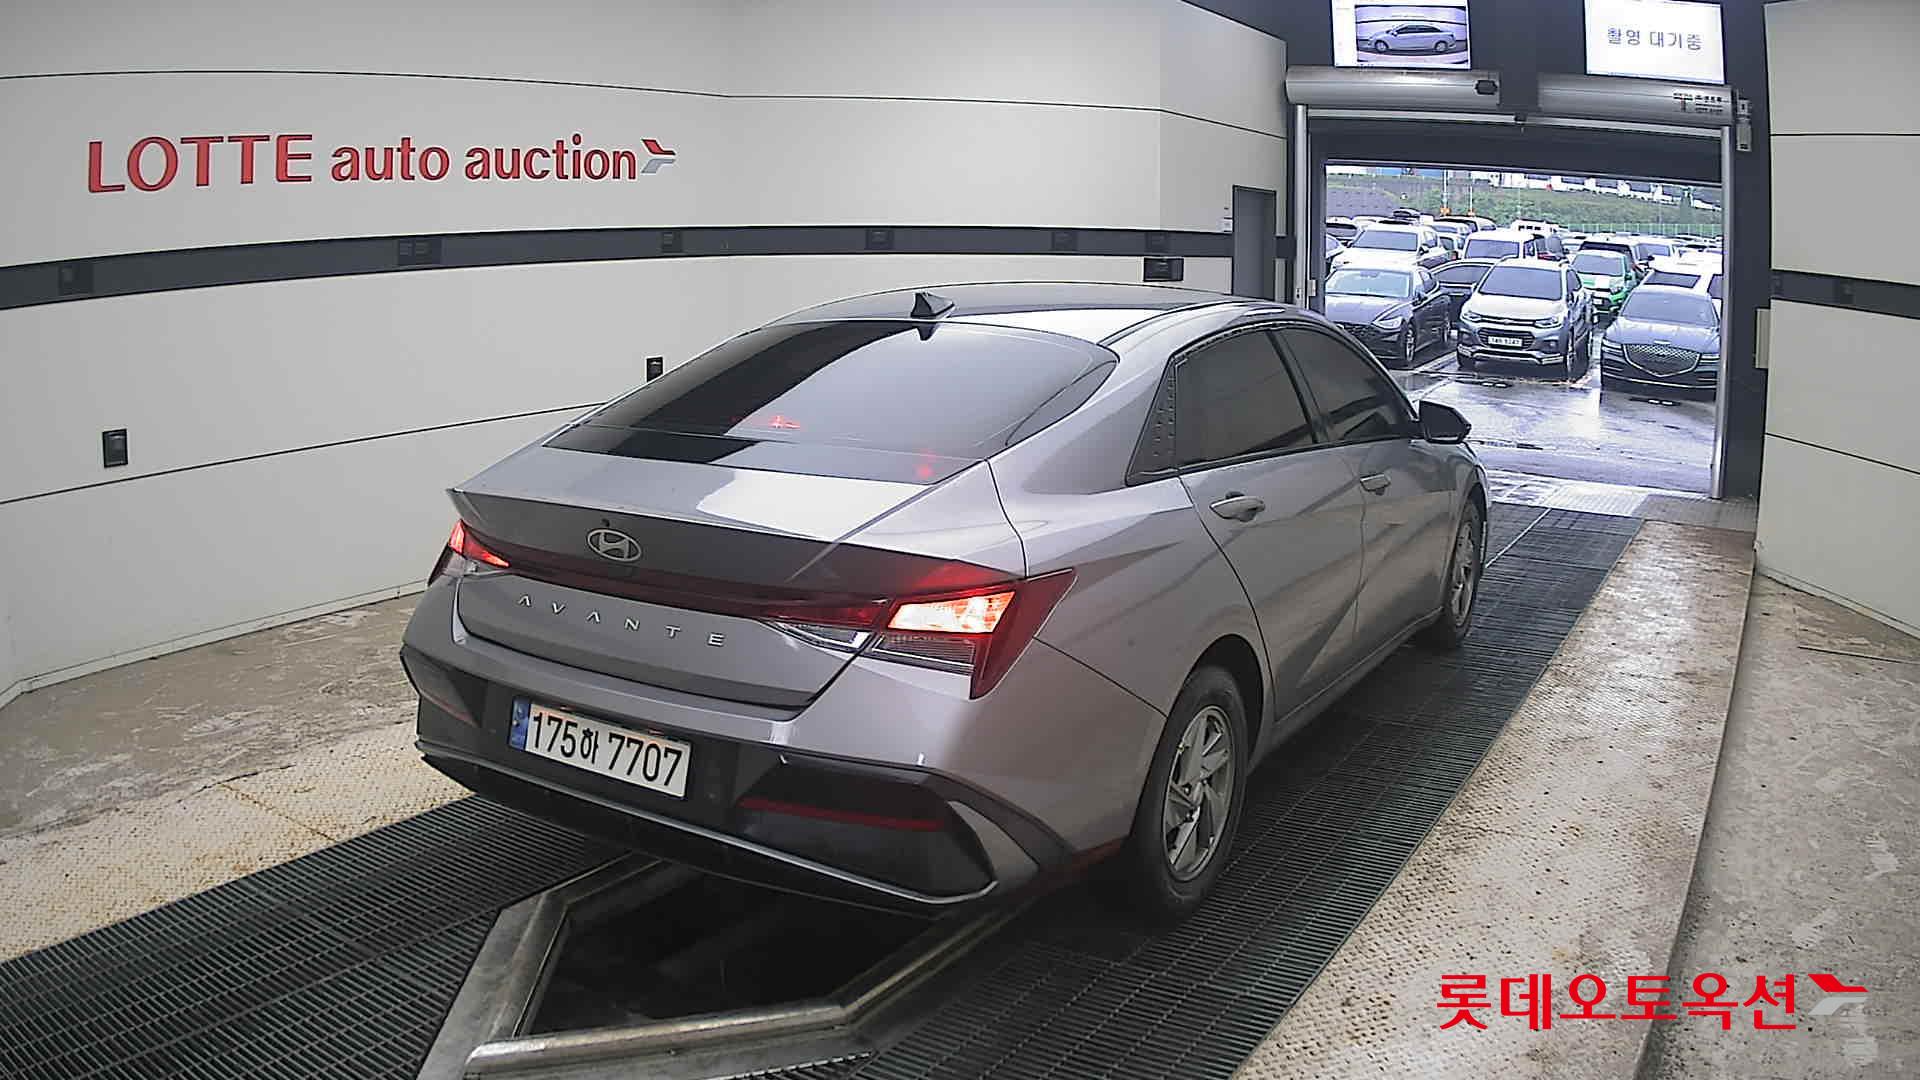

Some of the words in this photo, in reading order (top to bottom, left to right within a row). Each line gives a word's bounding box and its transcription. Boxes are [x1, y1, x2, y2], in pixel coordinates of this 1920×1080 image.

[1649, 31, 1702, 51] 대기중
[88, 134, 313, 193] LOTTE
[331, 137, 450, 181] auto
[463, 133, 637, 180] auction
[518, 594, 725, 647] AVANTE
[533, 711, 599, 764] 175하
[608, 731, 683, 786] 7707
